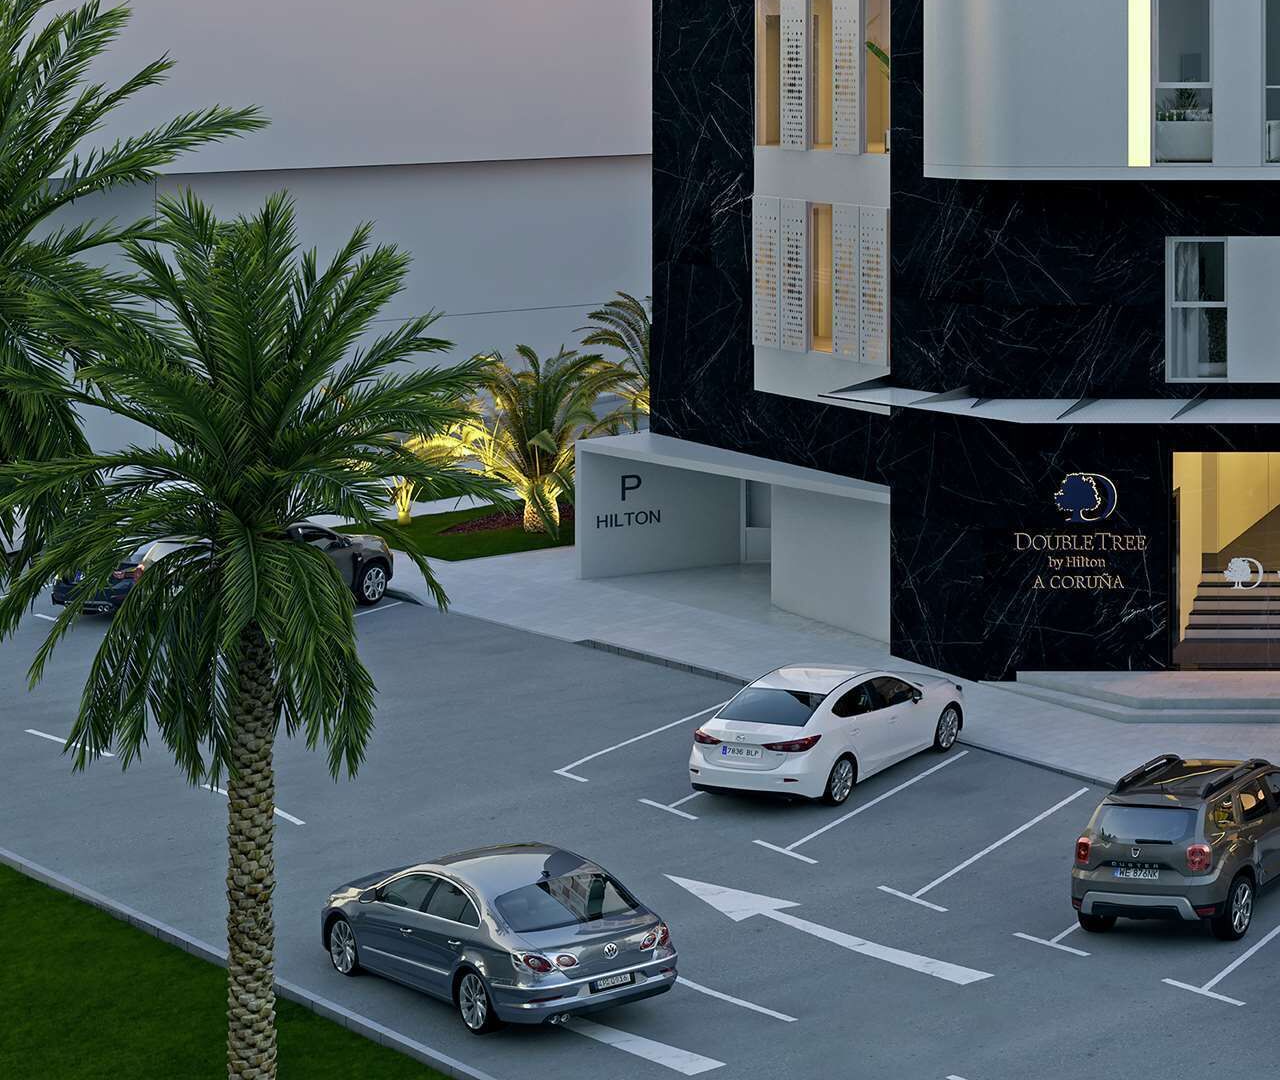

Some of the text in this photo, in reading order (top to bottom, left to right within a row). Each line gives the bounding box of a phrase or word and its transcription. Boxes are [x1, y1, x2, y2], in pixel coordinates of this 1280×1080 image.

[620, 474, 642, 501] P
[596, 509, 661, 529] HILTON
[1013, 532, 1148, 551] DOUBLETREE
[1048, 556, 1106, 570] by Hilton
[1031, 573, 1125, 589] A CORUÑA
